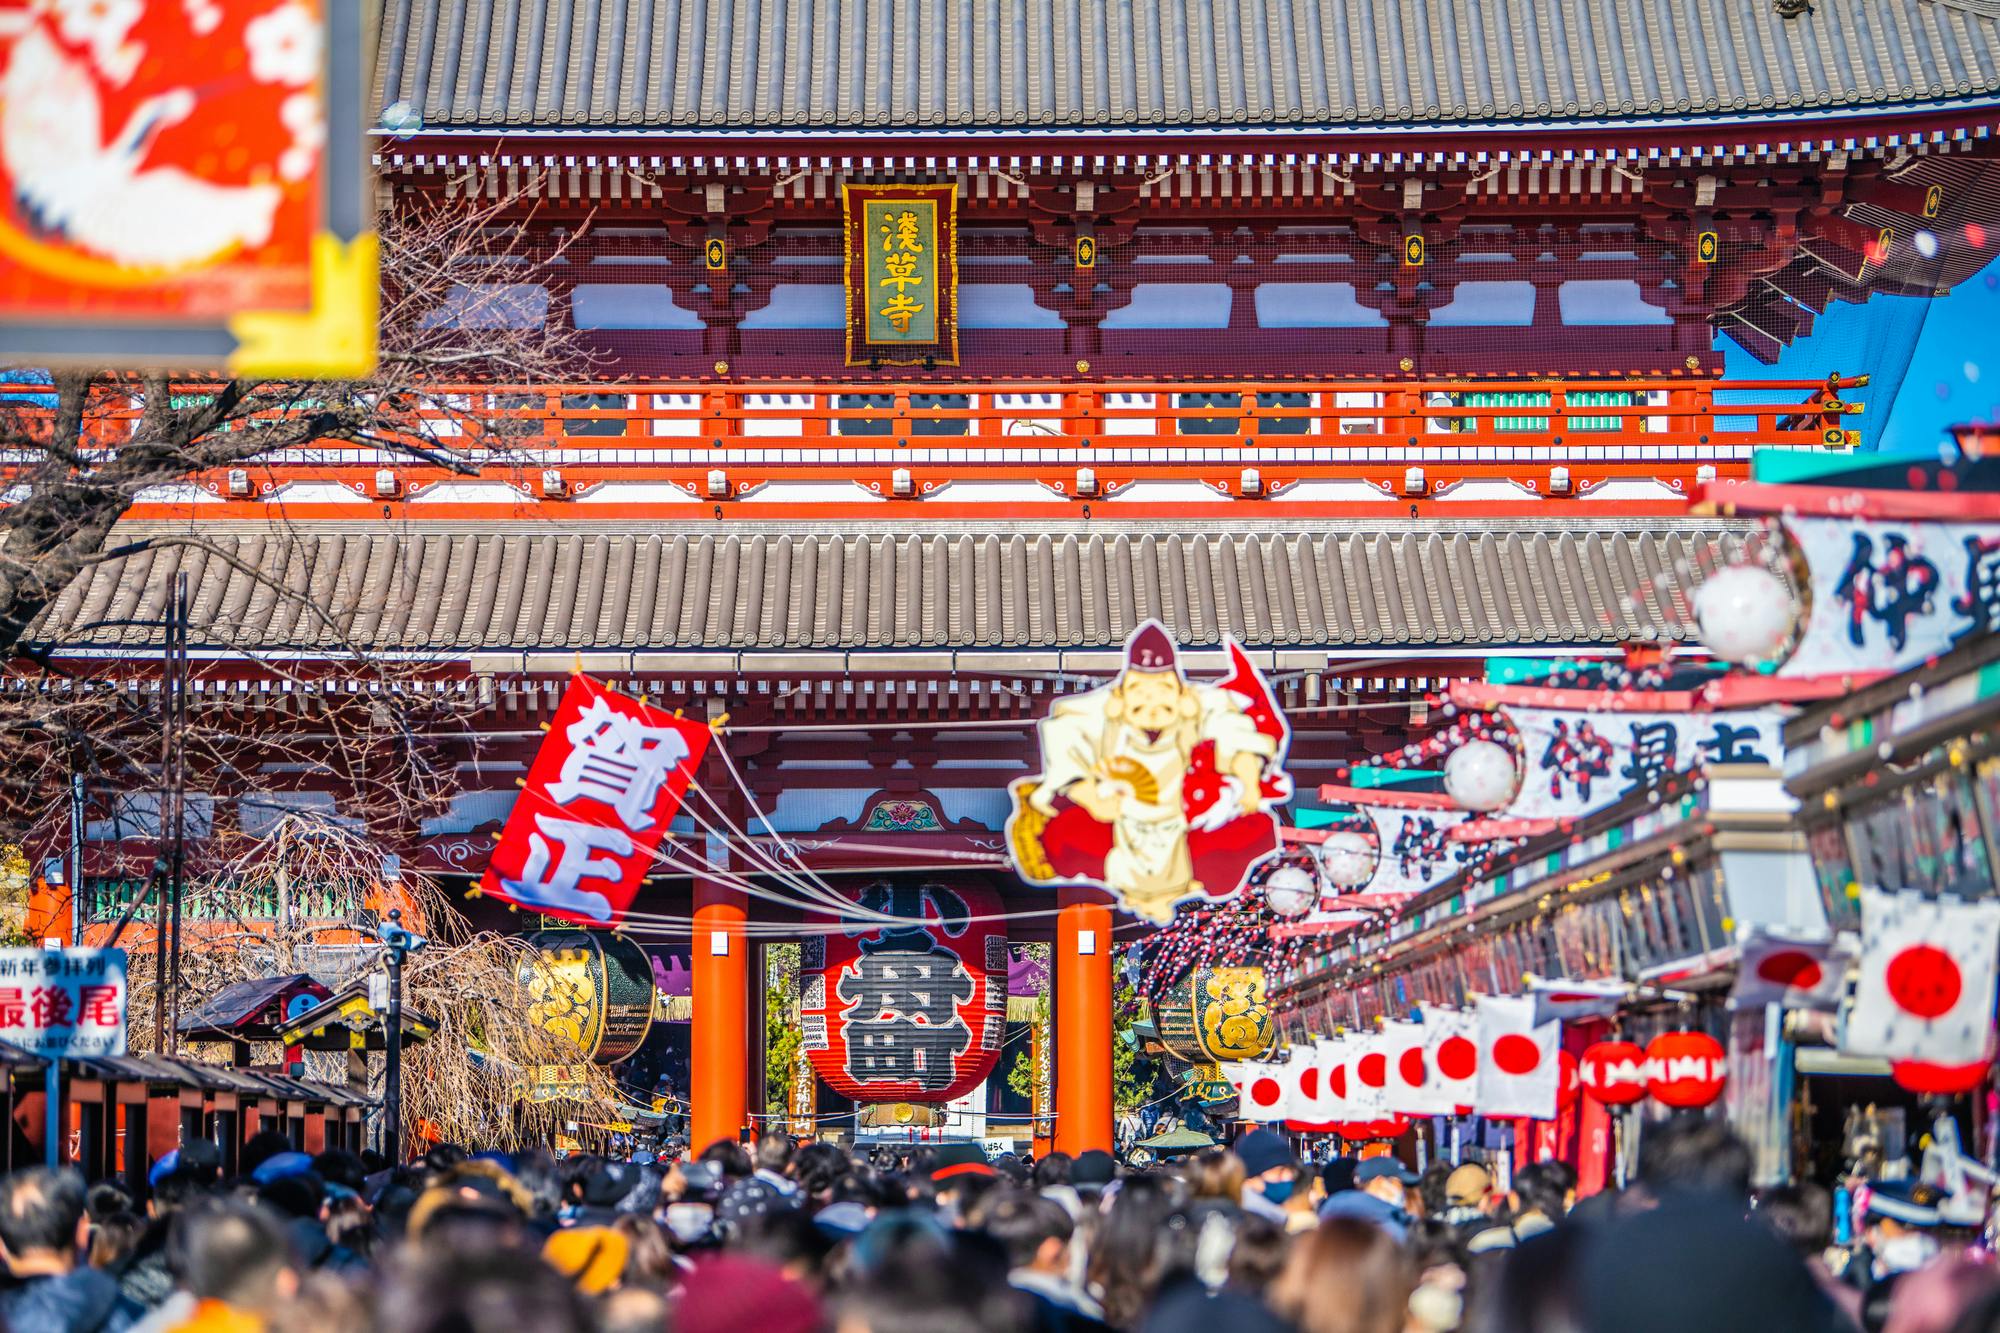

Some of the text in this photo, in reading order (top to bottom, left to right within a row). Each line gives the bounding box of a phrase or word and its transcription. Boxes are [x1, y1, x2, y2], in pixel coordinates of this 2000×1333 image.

[500, 695, 690, 922] 賀正
[0, 984, 119, 1029] 最後尾
[837, 877, 975, 1092] 小舟町
